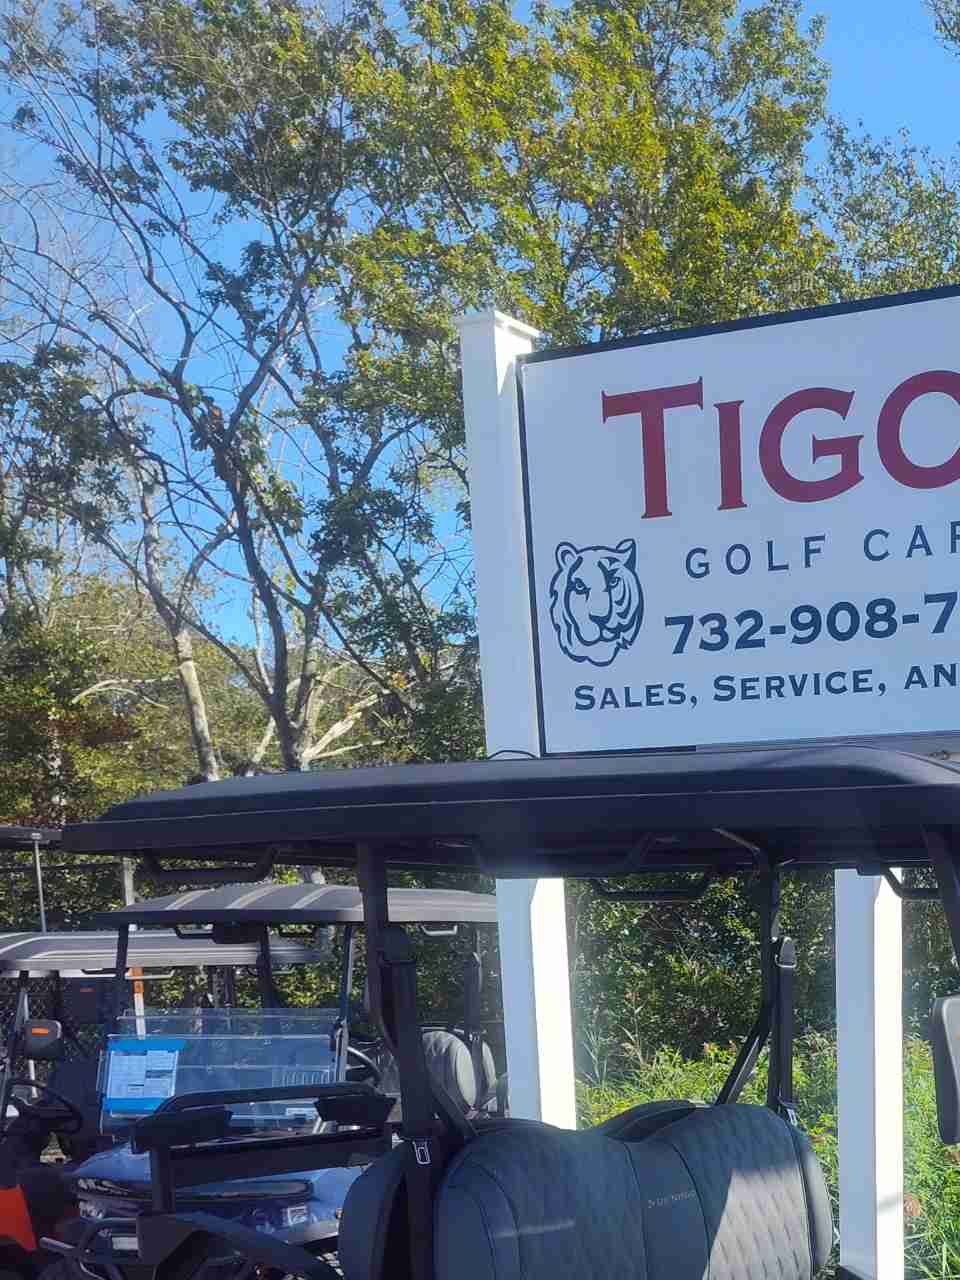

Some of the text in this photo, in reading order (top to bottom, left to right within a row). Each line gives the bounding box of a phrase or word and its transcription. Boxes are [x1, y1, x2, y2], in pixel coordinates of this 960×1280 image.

[685, 534, 826, 579] GOLF
[574, 683, 698, 712] SALES,
[713, 669, 887, 702] SERVICE,
